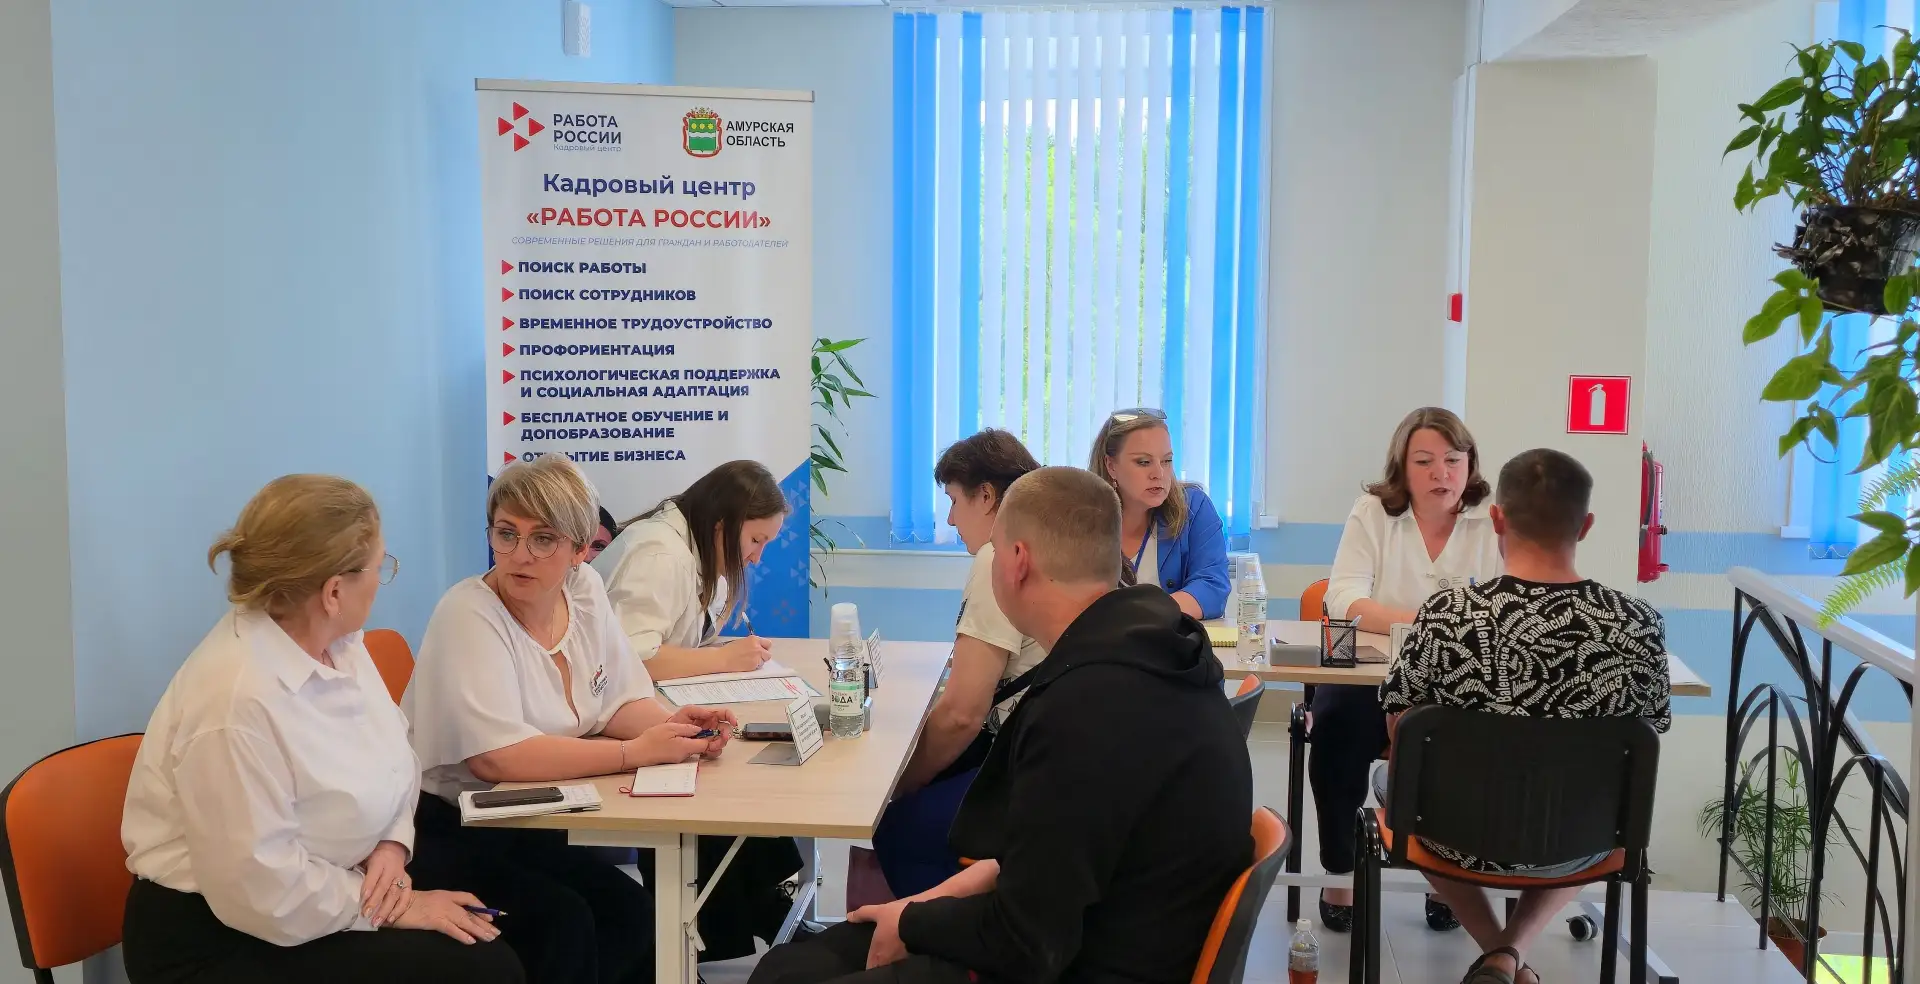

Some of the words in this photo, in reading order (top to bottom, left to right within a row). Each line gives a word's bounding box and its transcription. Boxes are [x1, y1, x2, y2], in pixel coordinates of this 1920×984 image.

[553, 113, 619, 128] РАБОТА
[726, 120, 794, 133] АМУРСКАЯ
[553, 129, 622, 145] РОССИИ
[726, 135, 786, 147] ОБЛАСТЬ
[553, 143, 595, 152] Кадровый
[597, 145, 622, 153] центр
[543, 173, 674, 198] Кадровый
[682, 180, 756, 201] центр
[526, 207, 647, 227] «РАБОТА
[654, 209, 771, 229] РОССИИ»
[511, 236, 586, 246] СОВРЕМЕННЫЕ
[588, 237, 635, 247] РЕШЕНИЯ
[635, 238, 656, 248] ДЛЯ
[658, 238, 702, 248] ГРАЖДАН
[703, 239, 711, 248] И
[712, 239, 789, 249] РАБОТОДАТЕЛЕЙ
[518, 261, 575, 273] ПОИСК
[579, 262, 647, 274] РАБОТЫ
[518, 288, 576, 300] ПОИСК
[579, 289, 697, 302] СОТРУДНИКОВ
[519, 318, 618, 330] ВРЕМЕННОЕ
[621, 315, 773, 331] ТРУДОУСТРОЙСТВО
[519, 344, 675, 358] ПРОФОРИЕНТАЦИЯ
[520, 369, 680, 381] ПСИХОЛОГИЧЕСКАЯ
[683, 368, 781, 382] ПОДДЕРЖКА
[520, 386, 532, 398] И
[536, 386, 648, 400] СОЦИАЛЬНАЯ
[652, 385, 750, 399] АДАПТАЦИЯ
[520, 412, 628, 424] БЕСПЛАТНОЕ
[631, 410, 714, 422] ОБУЧЕНИЕ
[717, 410, 729, 421] И
[520, 427, 675, 441] ДОПОБРАЗОВАНИЕ
[522, 451, 610, 462] ОТЫТИЕ
[613, 449, 687, 462] БИЗНЕСА
